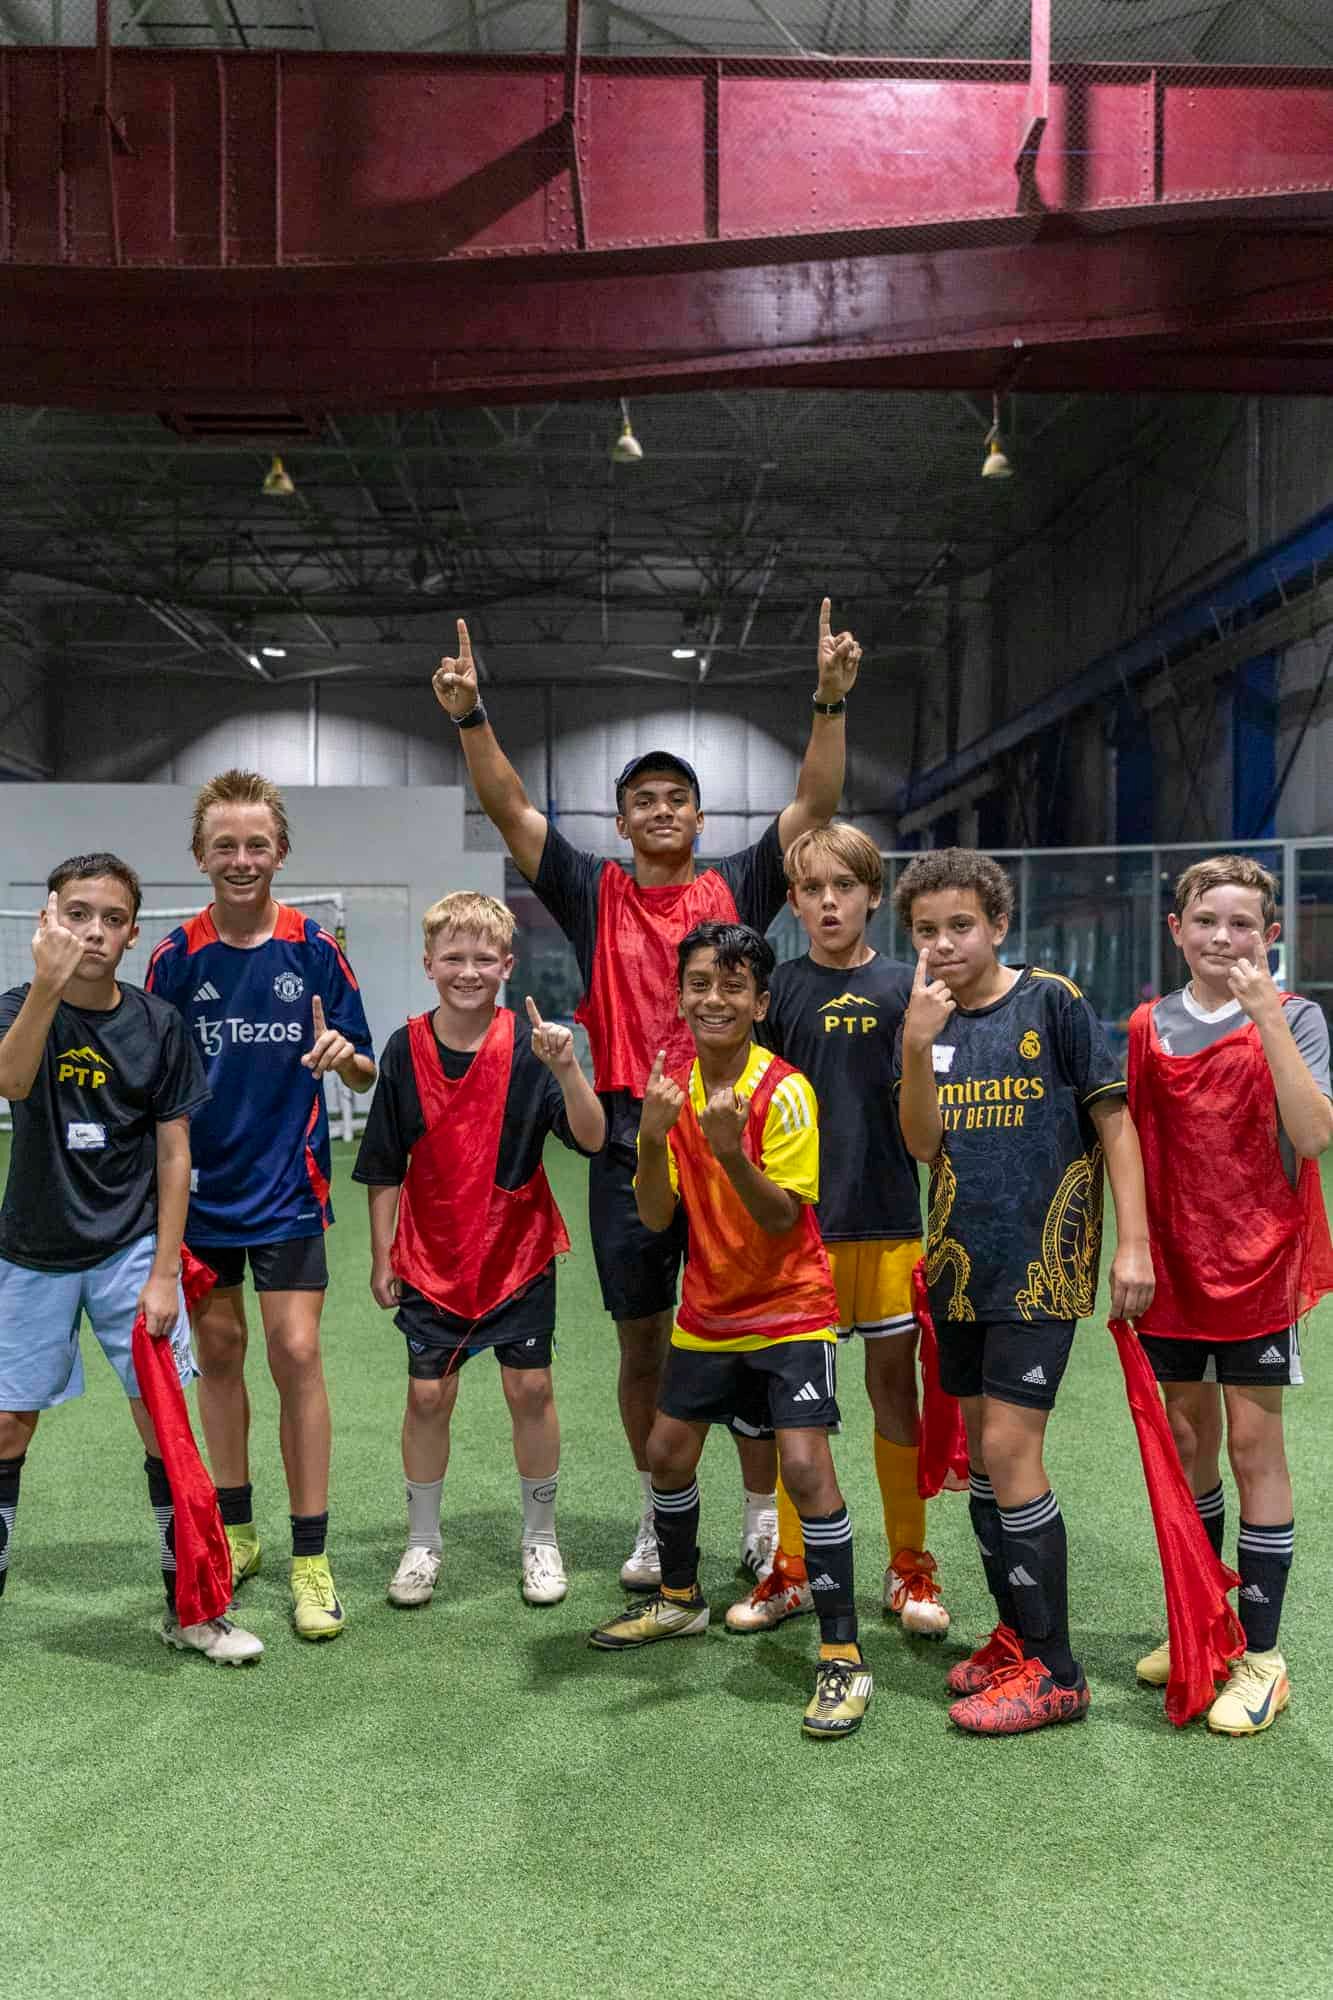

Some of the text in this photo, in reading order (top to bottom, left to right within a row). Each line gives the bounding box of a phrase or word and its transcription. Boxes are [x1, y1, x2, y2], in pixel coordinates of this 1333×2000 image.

[225, 1018, 302, 1043] Tezos
[823, 1015, 877, 1034] PTP
[59, 1064, 106, 1088] PTP
[936, 1075, 1045, 1105] mirates
[941, 1105, 1024, 1131] LY BETTER
